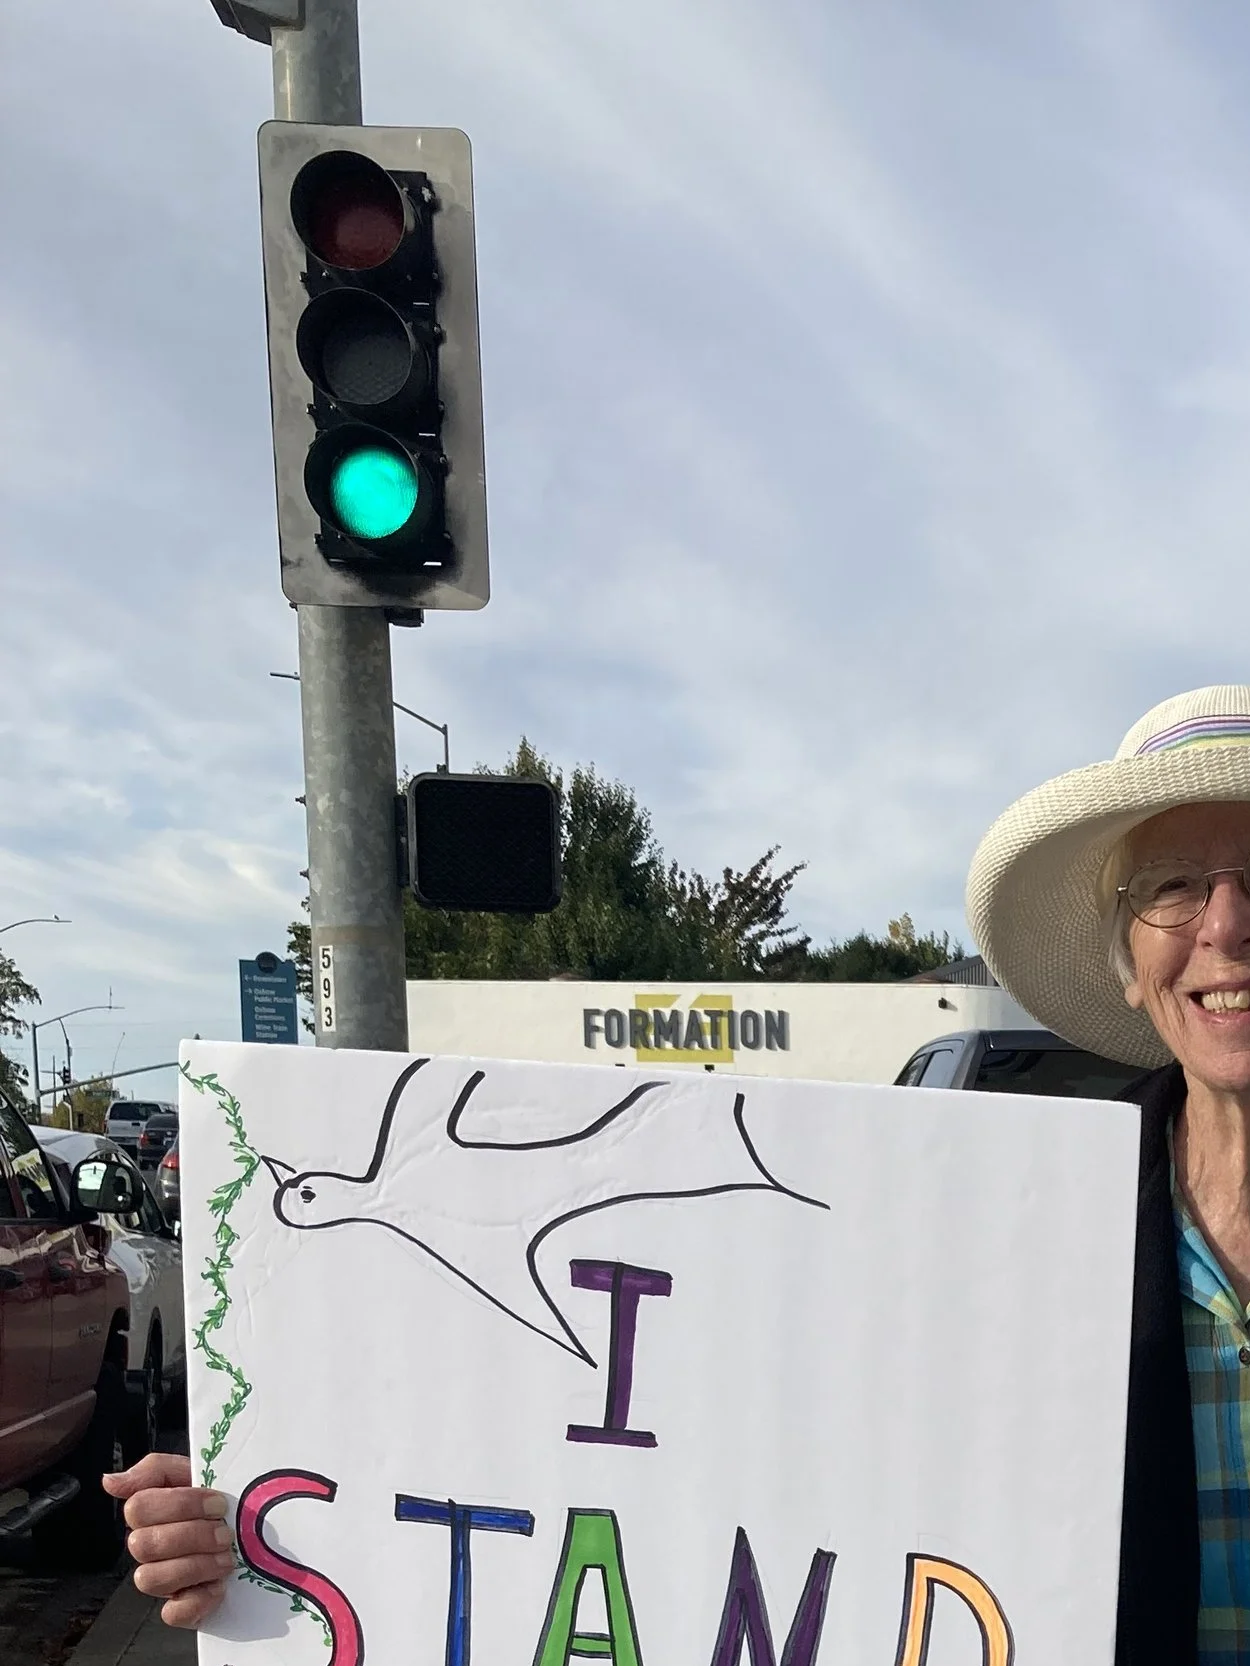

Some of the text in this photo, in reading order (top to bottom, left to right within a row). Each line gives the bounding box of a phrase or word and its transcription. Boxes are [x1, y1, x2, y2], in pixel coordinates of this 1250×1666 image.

[321, 948, 333, 1027] 593
[583, 1008, 790, 1051] FORMATION
[567, 1259, 673, 1448] I
